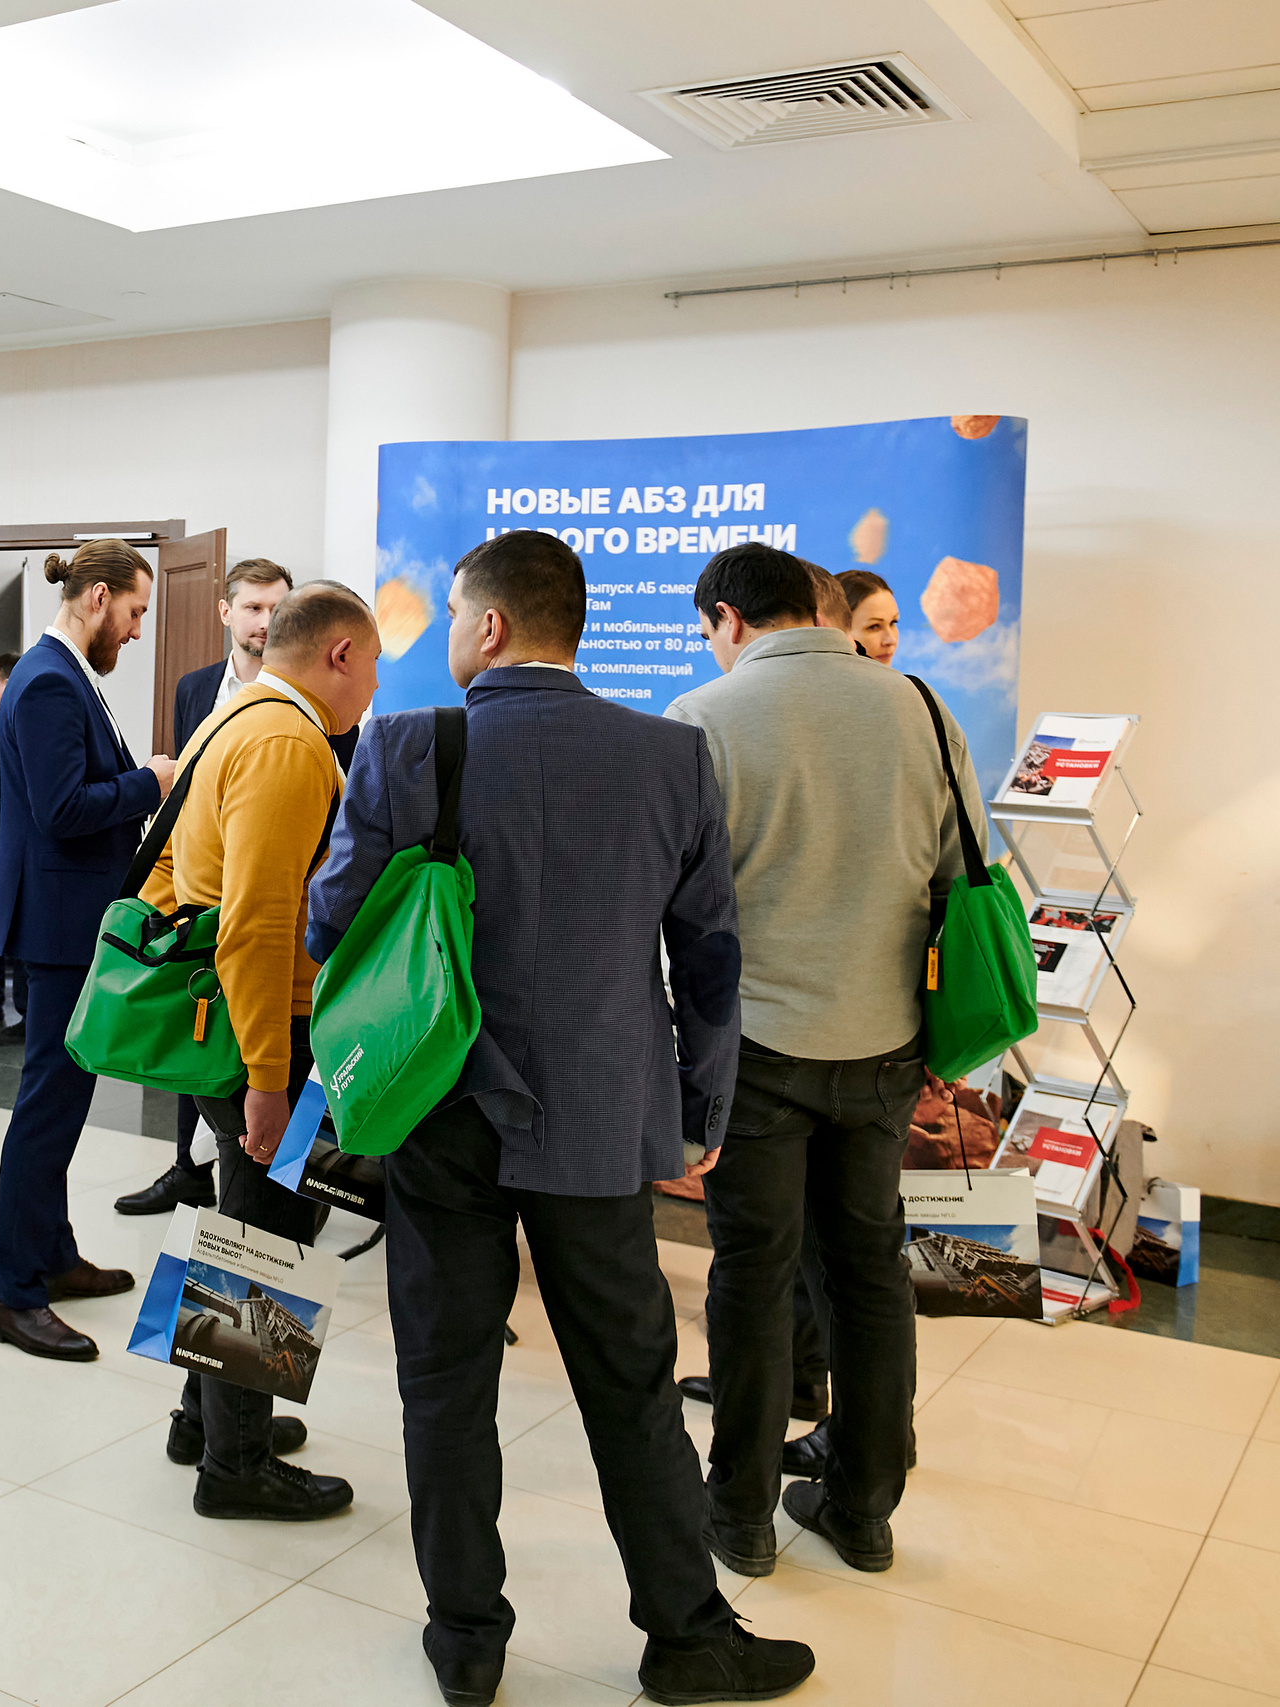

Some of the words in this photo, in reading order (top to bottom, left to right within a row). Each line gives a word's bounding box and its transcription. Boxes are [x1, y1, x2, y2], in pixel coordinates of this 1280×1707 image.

[486, 487, 611, 515] НОВЫЕ
[617, 486, 687, 514] АБЗ
[692, 483, 766, 518] ДЛЯ
[635, 524, 797, 554] ВРЕМЕНИ
[636, 581, 657, 594] АБ
[659, 584, 697, 594] смес
[591, 622, 601, 632] и
[603, 620, 684, 633] мобильные
[645, 641, 661, 650] от
[664, 638, 682, 651] 80
[684, 641, 703, 653] до
[591, 663, 693, 677] комплектаций
[337, 1047, 364, 1083] УРАЛЬСКИЙ
[340, 1075, 354, 1091] ПУТЬ
[908, 1195, 964, 1203] ДОСТИЖЕНИЕ
[198, 1239, 221, 1252] НОВЫХ
[221, 1247, 242, 1260] ВЫСОТ
[199, 1229, 246, 1252] ВДОХНОВЛЯЮТ
[245, 1246, 255, 1255] НА
[254, 1250, 295, 1270] ДОСТИЖЕНИЕ
